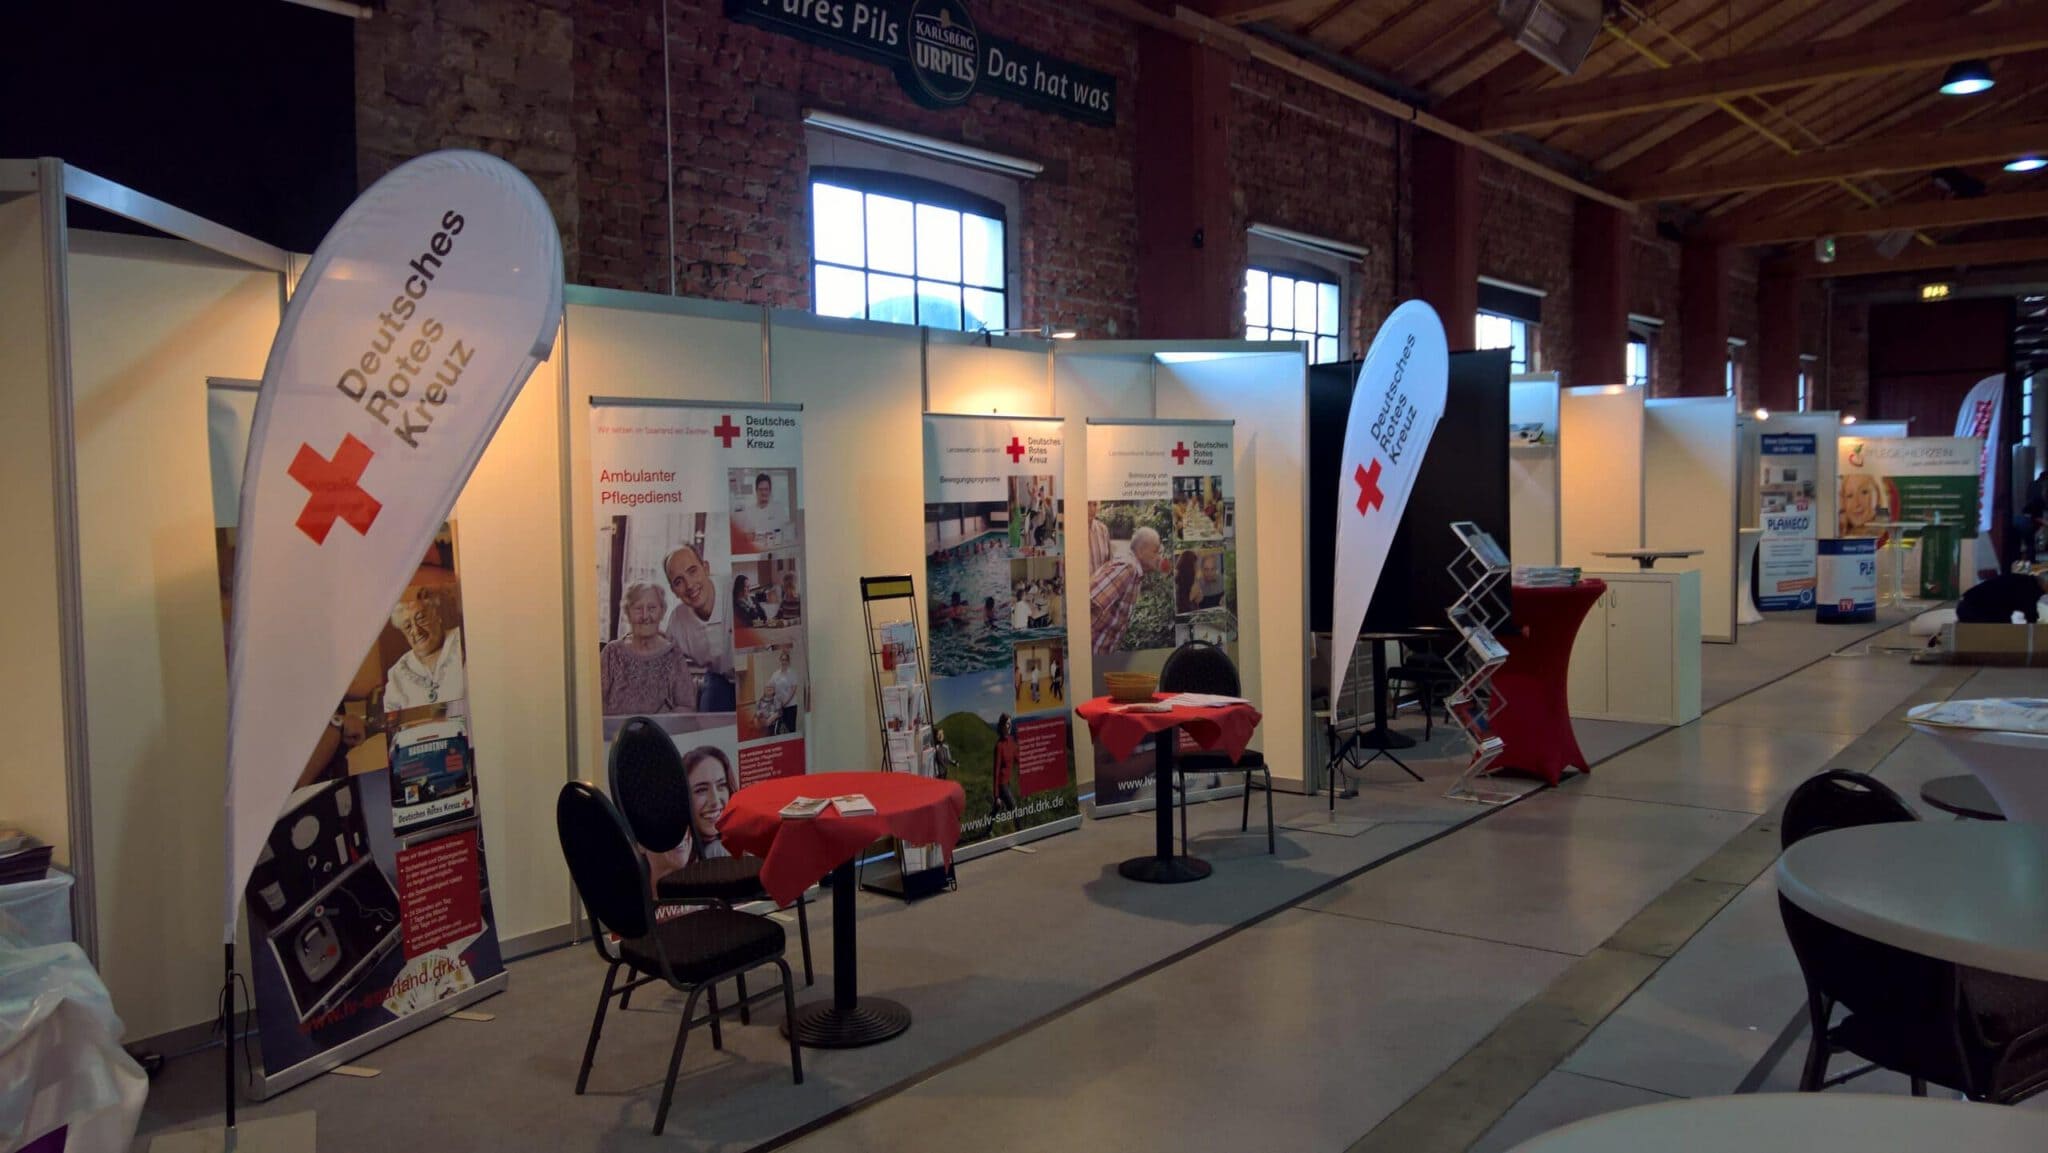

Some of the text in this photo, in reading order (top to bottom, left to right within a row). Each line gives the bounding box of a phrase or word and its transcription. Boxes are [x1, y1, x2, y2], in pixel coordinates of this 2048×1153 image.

[763, 0, 898, 46] ures Pils
[915, 19, 975, 51] KARLSBERG
[915, 42, 976, 82] URPILS
[987, 48, 1110, 111] Das hat was
[336, 209, 465, 403] Deutsches
[364, 317, 444, 426] Rotes
[1370, 333, 1416, 441] Deutsches
[394, 339, 475, 449] Kreuz
[745, 415, 796, 427] Deutsches
[746, 427, 774, 438] Rotes
[1379, 393, 1407, 453] Rotes
[1388, 404, 1418, 466] Kreuz
[746, 438, 775, 449] Kreuz
[1193, 440, 1228, 449] Deutsches
[1194, 449, 1213, 458] Rotes
[600, 469, 676, 483] Ambulanter
[1194, 458, 1213, 466] Kreuz
[601, 491, 682, 507] Pflegedienst
[1768, 517, 1809, 531] PLAMECO
